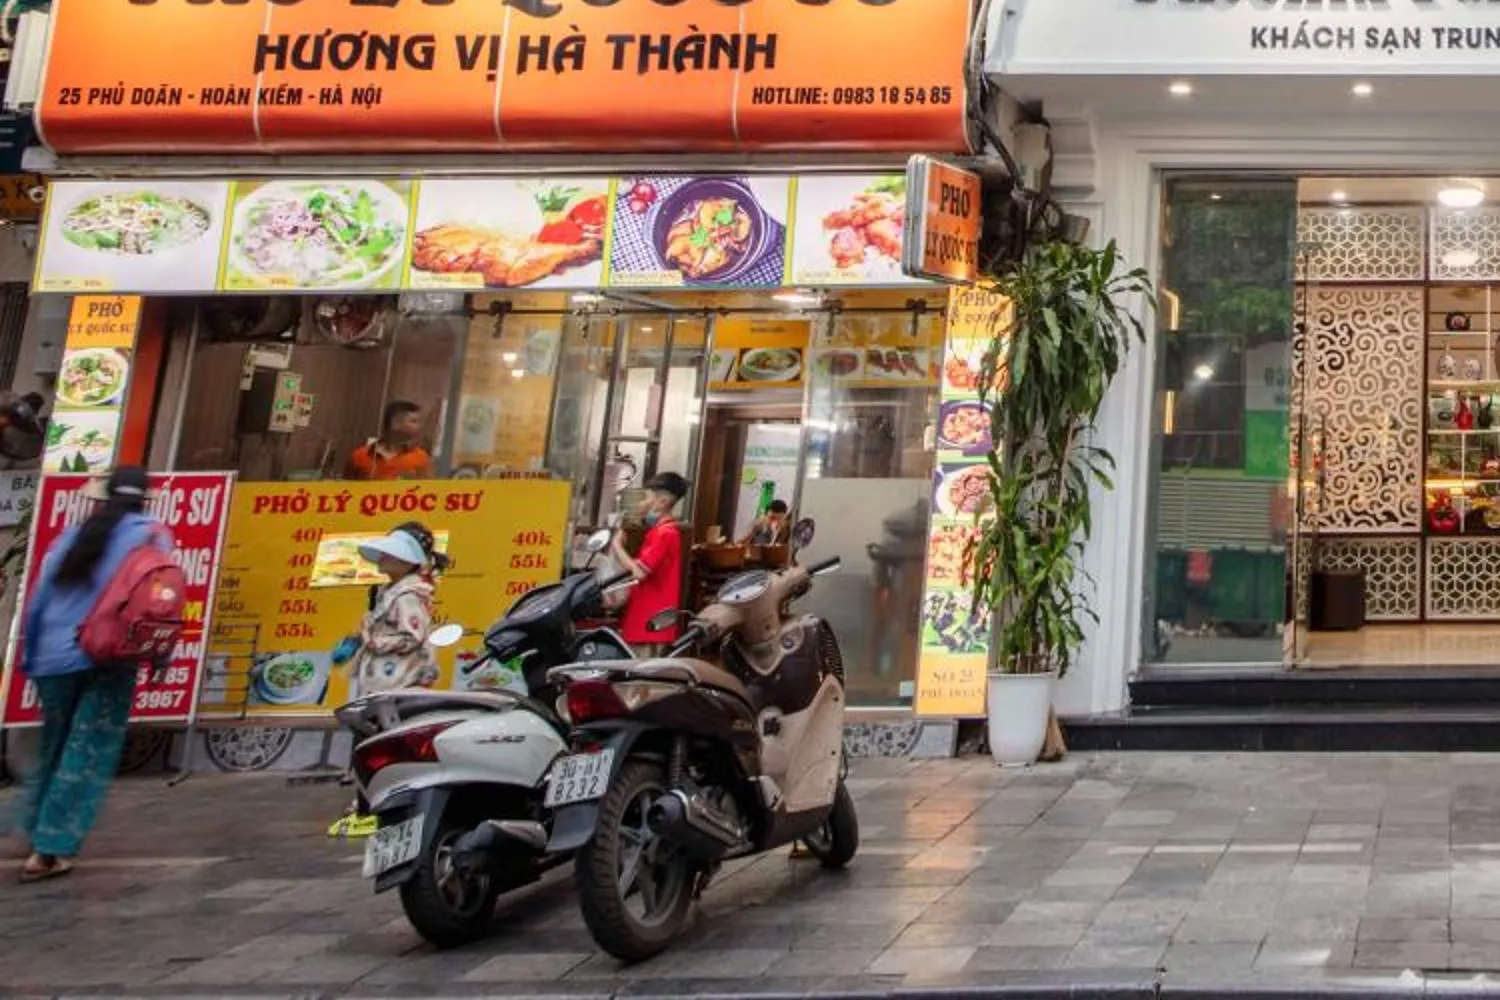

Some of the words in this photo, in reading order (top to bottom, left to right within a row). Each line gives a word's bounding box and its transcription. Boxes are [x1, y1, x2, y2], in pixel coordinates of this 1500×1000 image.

[1251, 19, 1354, 50] KHÁCH
[1365, 26, 1420, 54] SẠN
[253, 27, 436, 75] HƯƠNG
[455, 33, 501, 82] VỊ
[516, 24, 587, 75] HÀ
[606, 24, 777, 76] THÀNH
[58, 87, 82, 106] 25
[87, 80, 125, 105] PHỦ
[257, 81, 304, 106] KIẾM
[319, 83, 343, 106] HÀ
[351, 85, 382, 110] NỘI
[752, 86, 828, 105] HOTLINE:
[833, 86, 875, 105] 0983
[880, 85, 899, 104] 18
[904, 86, 926, 105] 54
[930, 86, 951, 105] 85
[186, 484, 221, 526] SƯ
[253, 488, 311, 514] PHỞ
[317, 489, 352, 514] LÝ
[360, 485, 438, 516] QUỐC
[444, 489, 484, 512] SƯ
[512, 530, 552, 547] 40k
[509, 554, 548, 569] 55k
[279, 599, 318, 614] 55k
[274, 623, 314, 638] 55k
